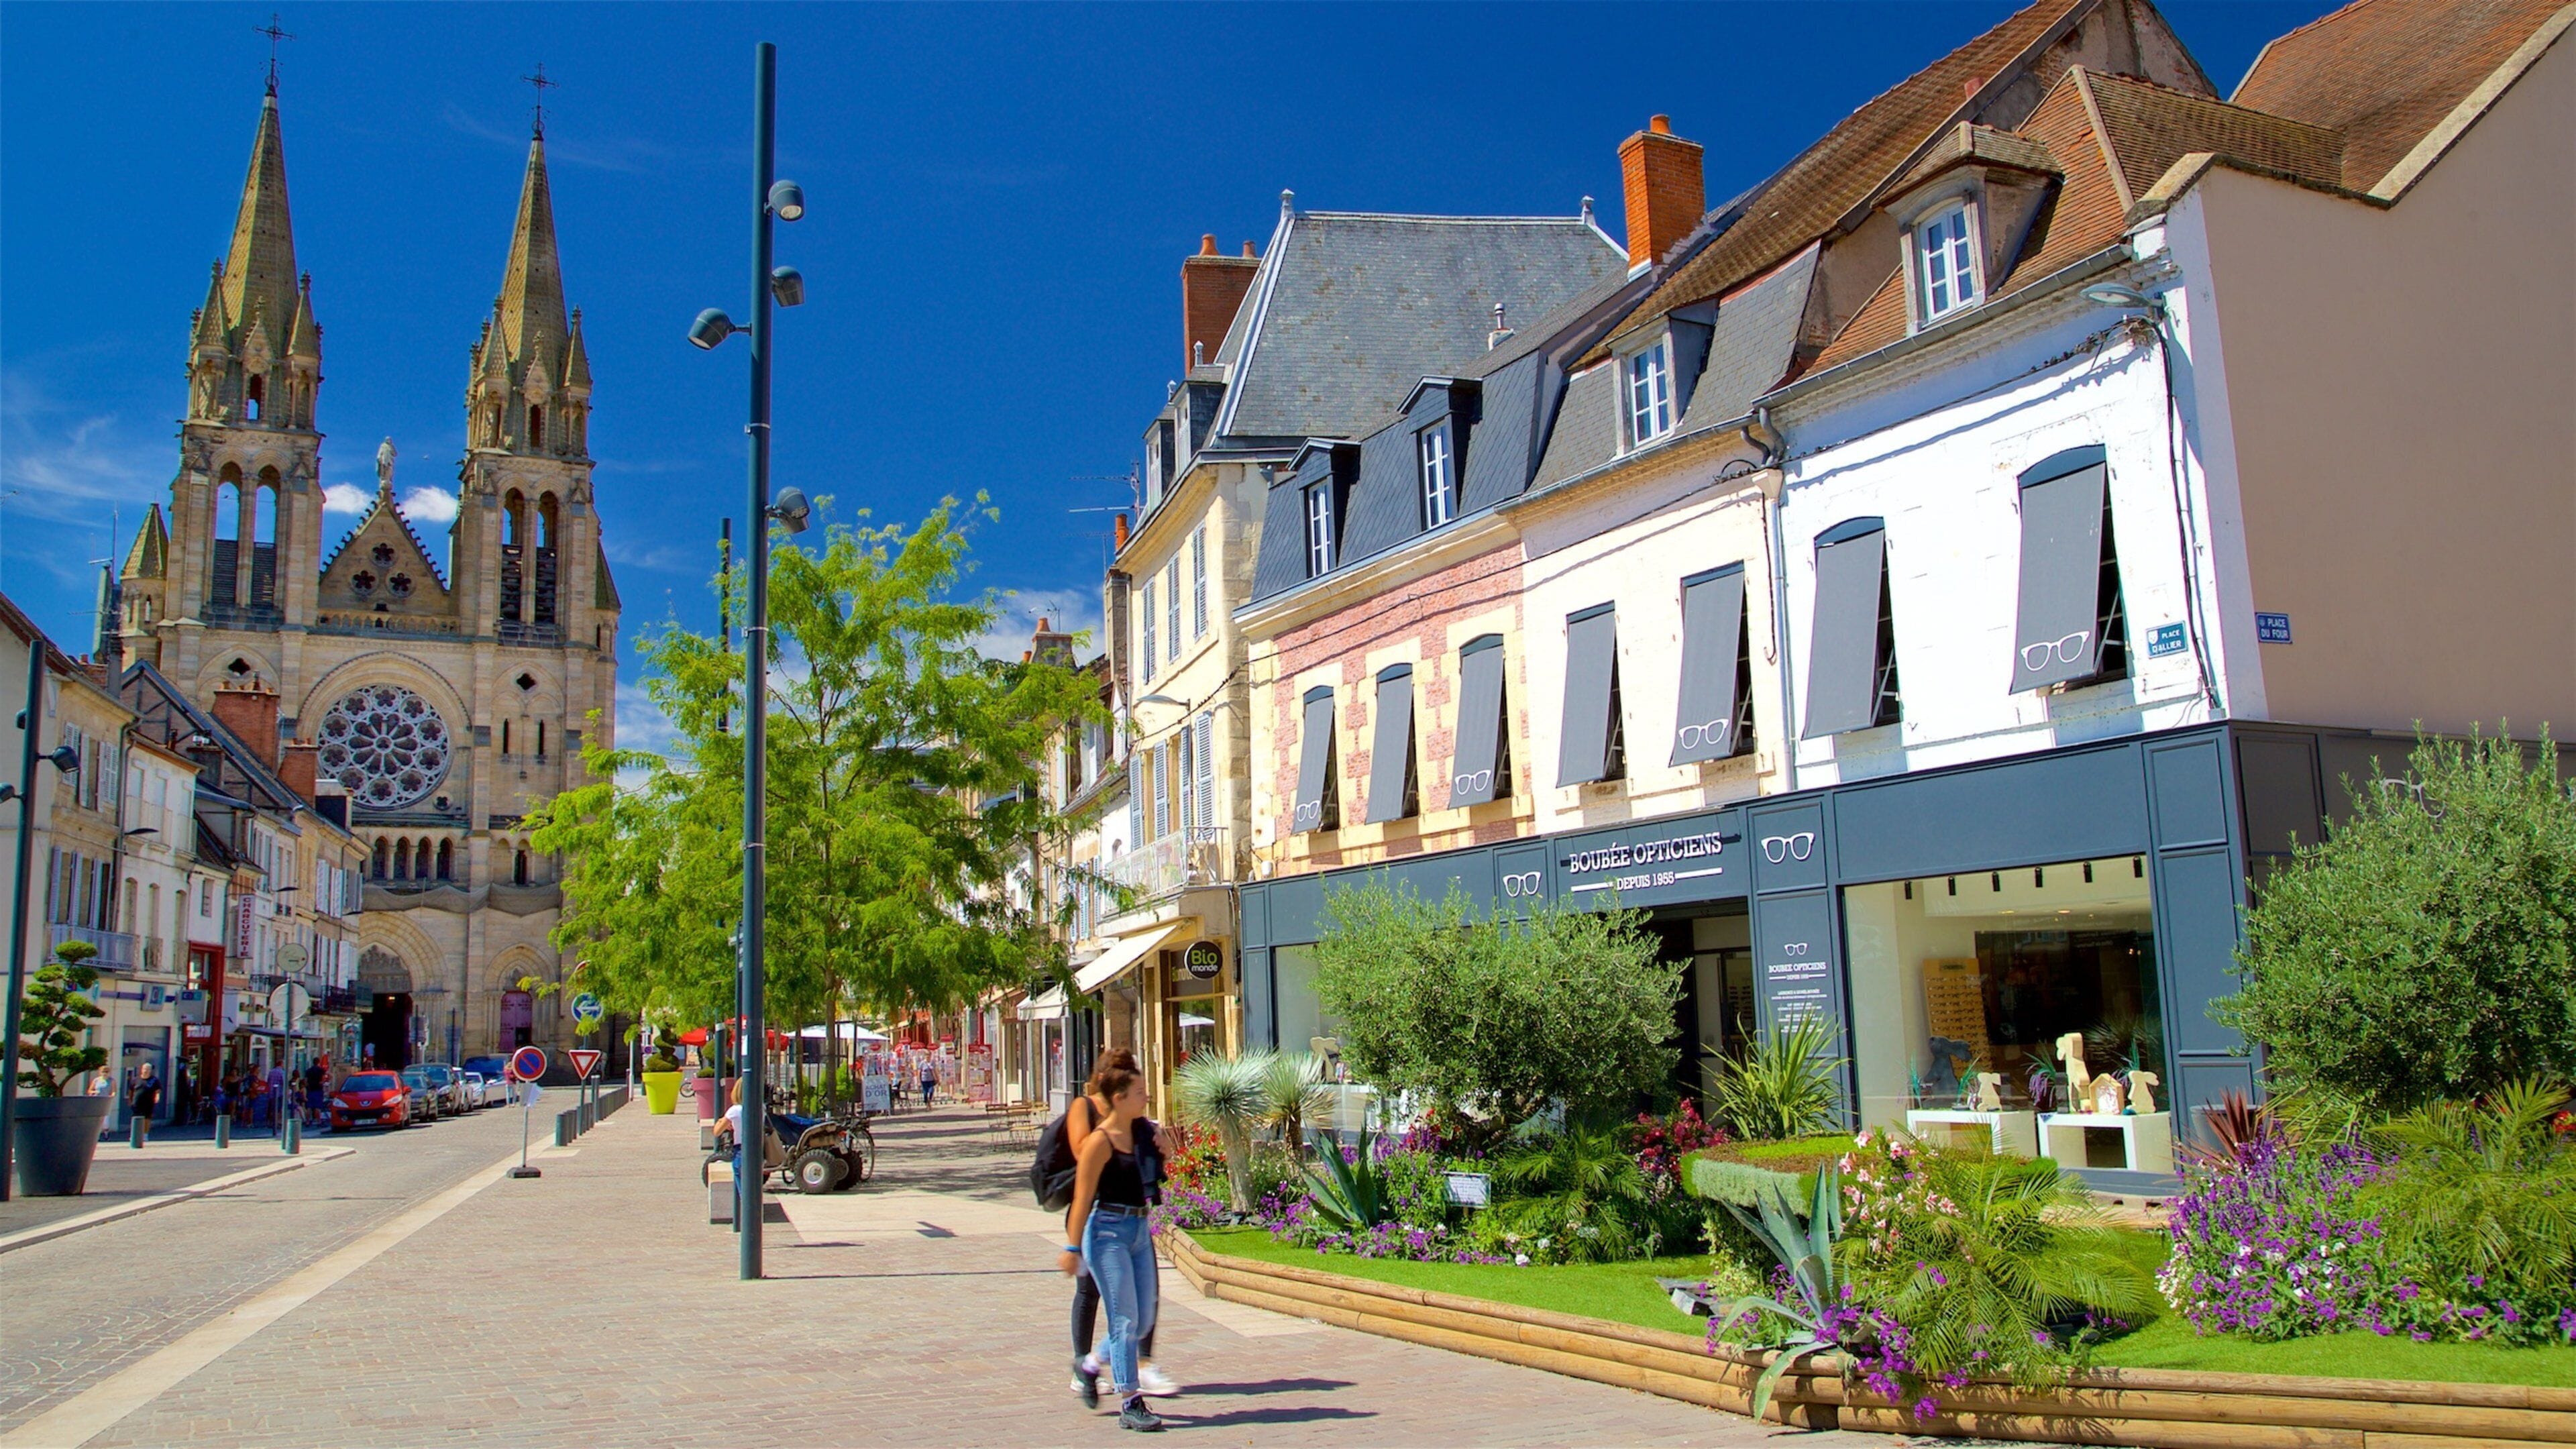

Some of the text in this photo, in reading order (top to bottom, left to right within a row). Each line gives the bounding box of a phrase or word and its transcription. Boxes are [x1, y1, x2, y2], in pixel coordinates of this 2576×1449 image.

[2267, 618, 2286, 628] PLACE
[2161, 629, 2180, 639] PLACE
[2261, 628, 2288, 639] DU FOUR
[1569, 832, 1723, 873] BOUBÉE OPTICIENS
[1617, 871, 1675, 891] DEPUIS 1955
[240, 898, 251, 957] CHARCUTERIE
[1191, 949, 1218, 965] Bio
[1191, 964, 1218, 972] monde
